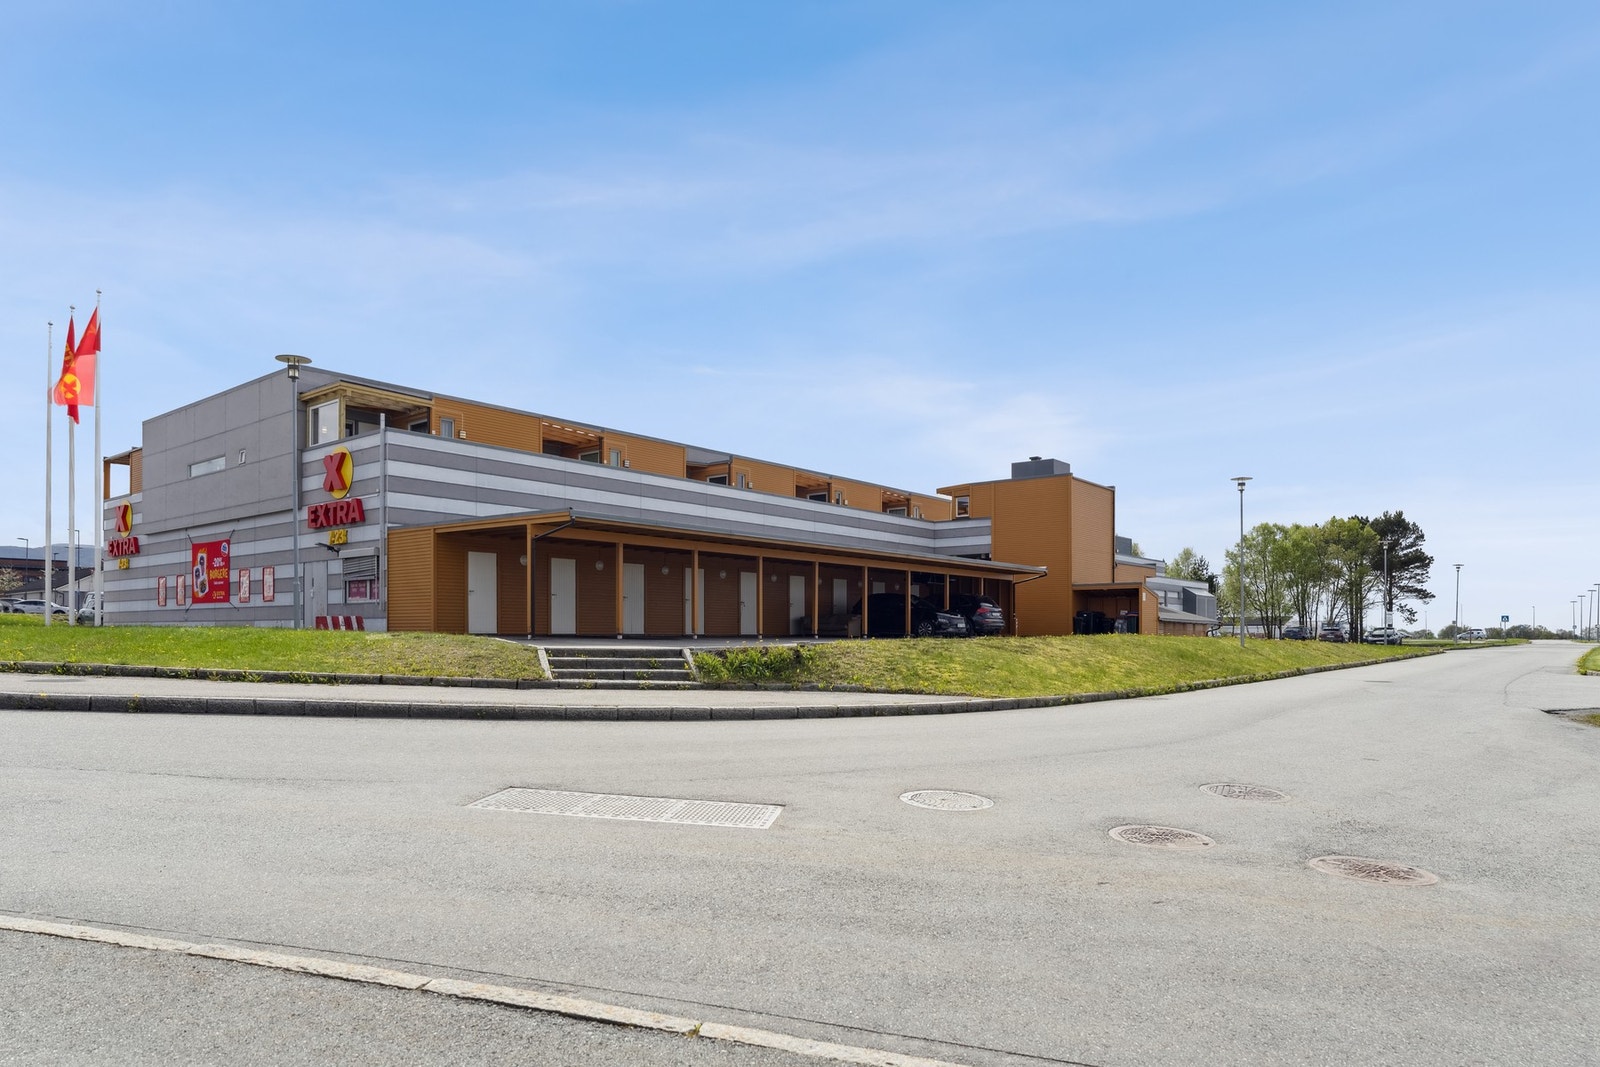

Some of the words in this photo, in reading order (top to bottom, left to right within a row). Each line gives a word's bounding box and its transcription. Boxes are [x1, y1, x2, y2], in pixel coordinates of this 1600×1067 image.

[323, 452, 347, 492] X
[115, 504, 130, 532] X
[307, 498, 365, 529] EXTRA
[107, 536, 140, 557] EXTRA
